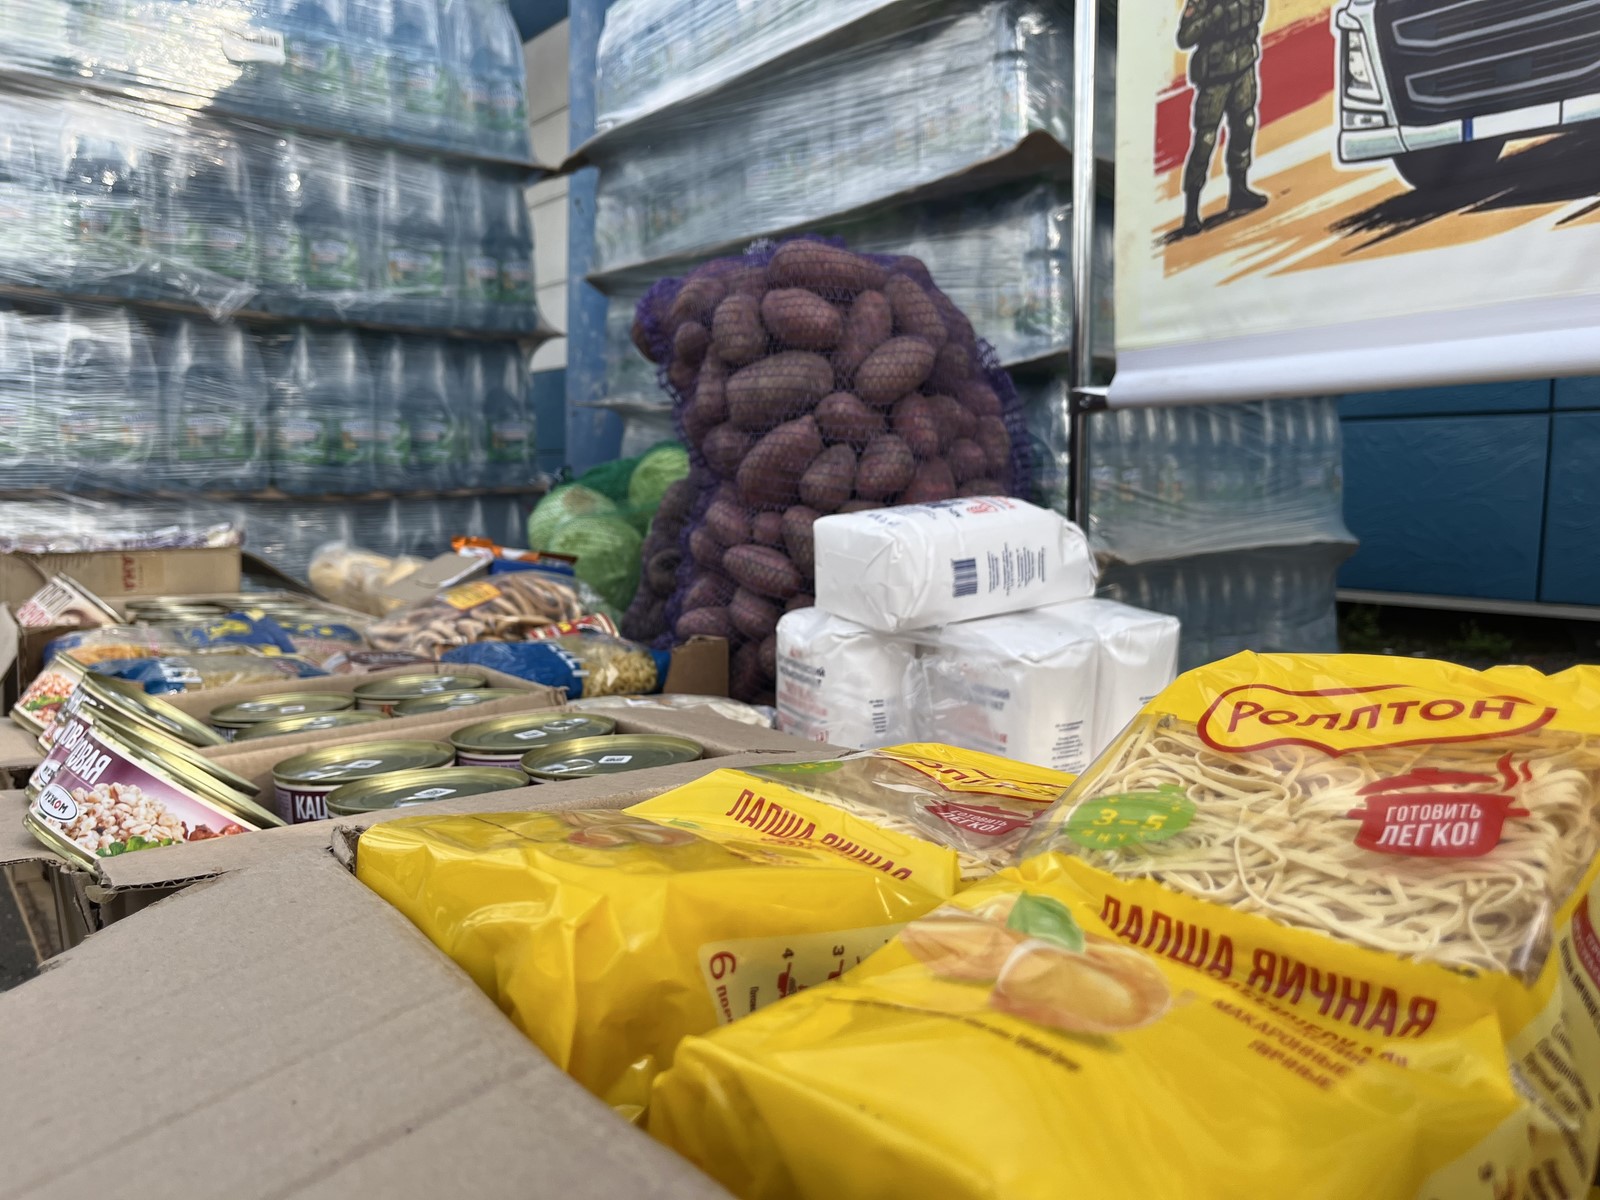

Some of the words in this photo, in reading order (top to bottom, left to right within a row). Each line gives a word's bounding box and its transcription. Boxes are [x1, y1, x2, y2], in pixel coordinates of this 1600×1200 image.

[1227, 699, 1516, 733] РОЛЛТОН
[725, 788, 816, 840] ЛАПША
[940, 811, 1002, 833] ЛЕГКО!
[950, 809, 1008, 827] ГОТОВИТЬ
[1385, 802, 1482, 823] ГОТОВИТЬ
[1376, 821, 1479, 848] ЛЕГКО!
[709, 950, 737, 980] 6
[1100, 894, 1234, 979] ЛАПША
[1248, 948, 1438, 1039] ЯИЧНАЯ
